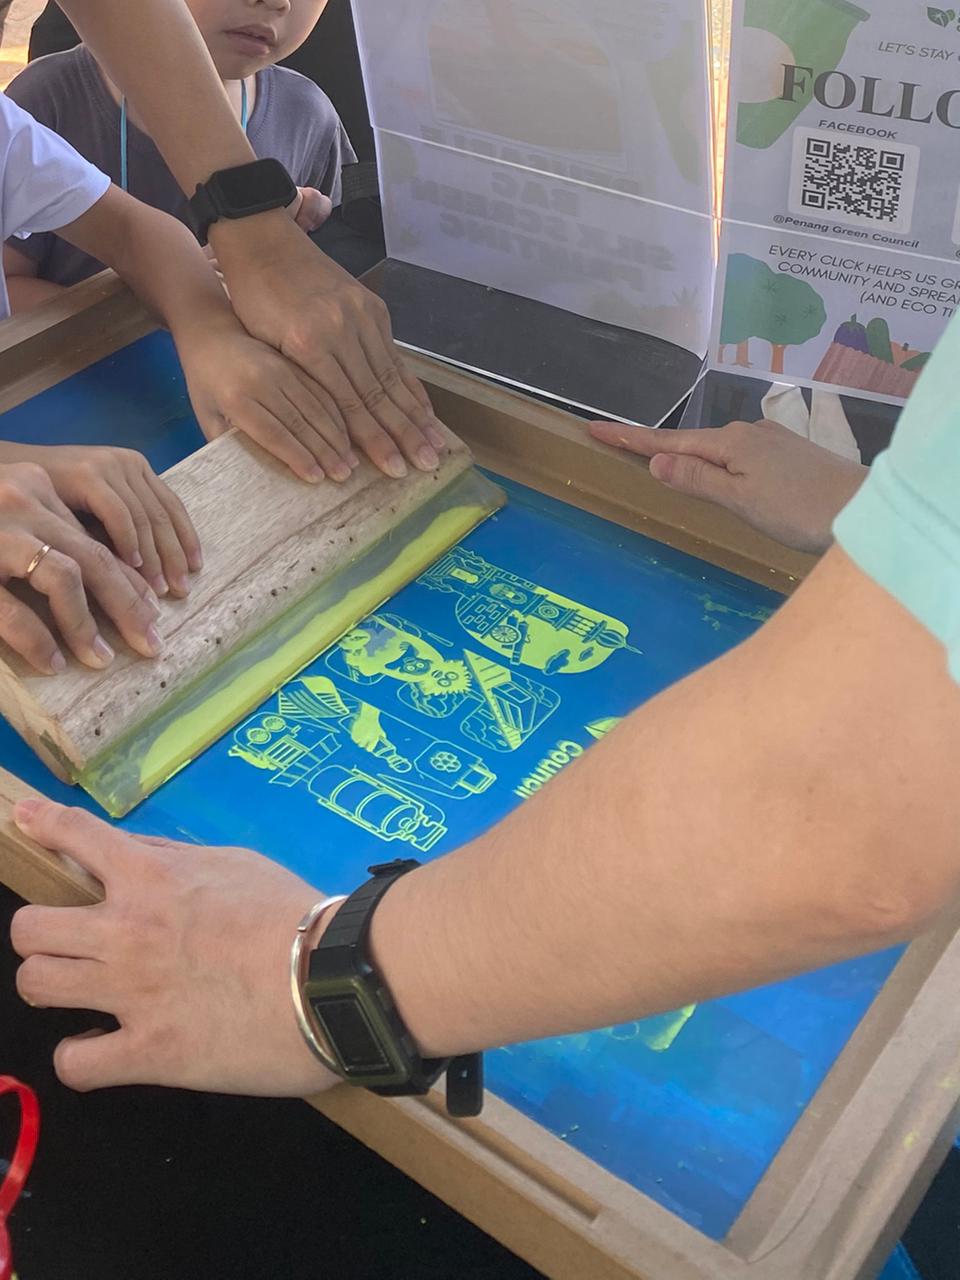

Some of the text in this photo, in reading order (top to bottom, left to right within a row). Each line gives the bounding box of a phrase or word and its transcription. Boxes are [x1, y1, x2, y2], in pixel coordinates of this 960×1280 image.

[878, 41, 916, 56] LET'S
[919, 47, 954, 60] STAY
[818, 119, 898, 139] FACEBOOK
[773, 214, 920, 248] @Penang Green Council
[768, 244, 817, 261] EVERY
[820, 255, 864, 271] CLICK
[865, 263, 913, 280] HELPS
[915, 273, 937, 285] US
[777, 261, 871, 287] COMMUNITY
[872, 280, 905, 293] AND
[859, 291, 898, 307] (AND
[900, 299, 937, 314] ECO
